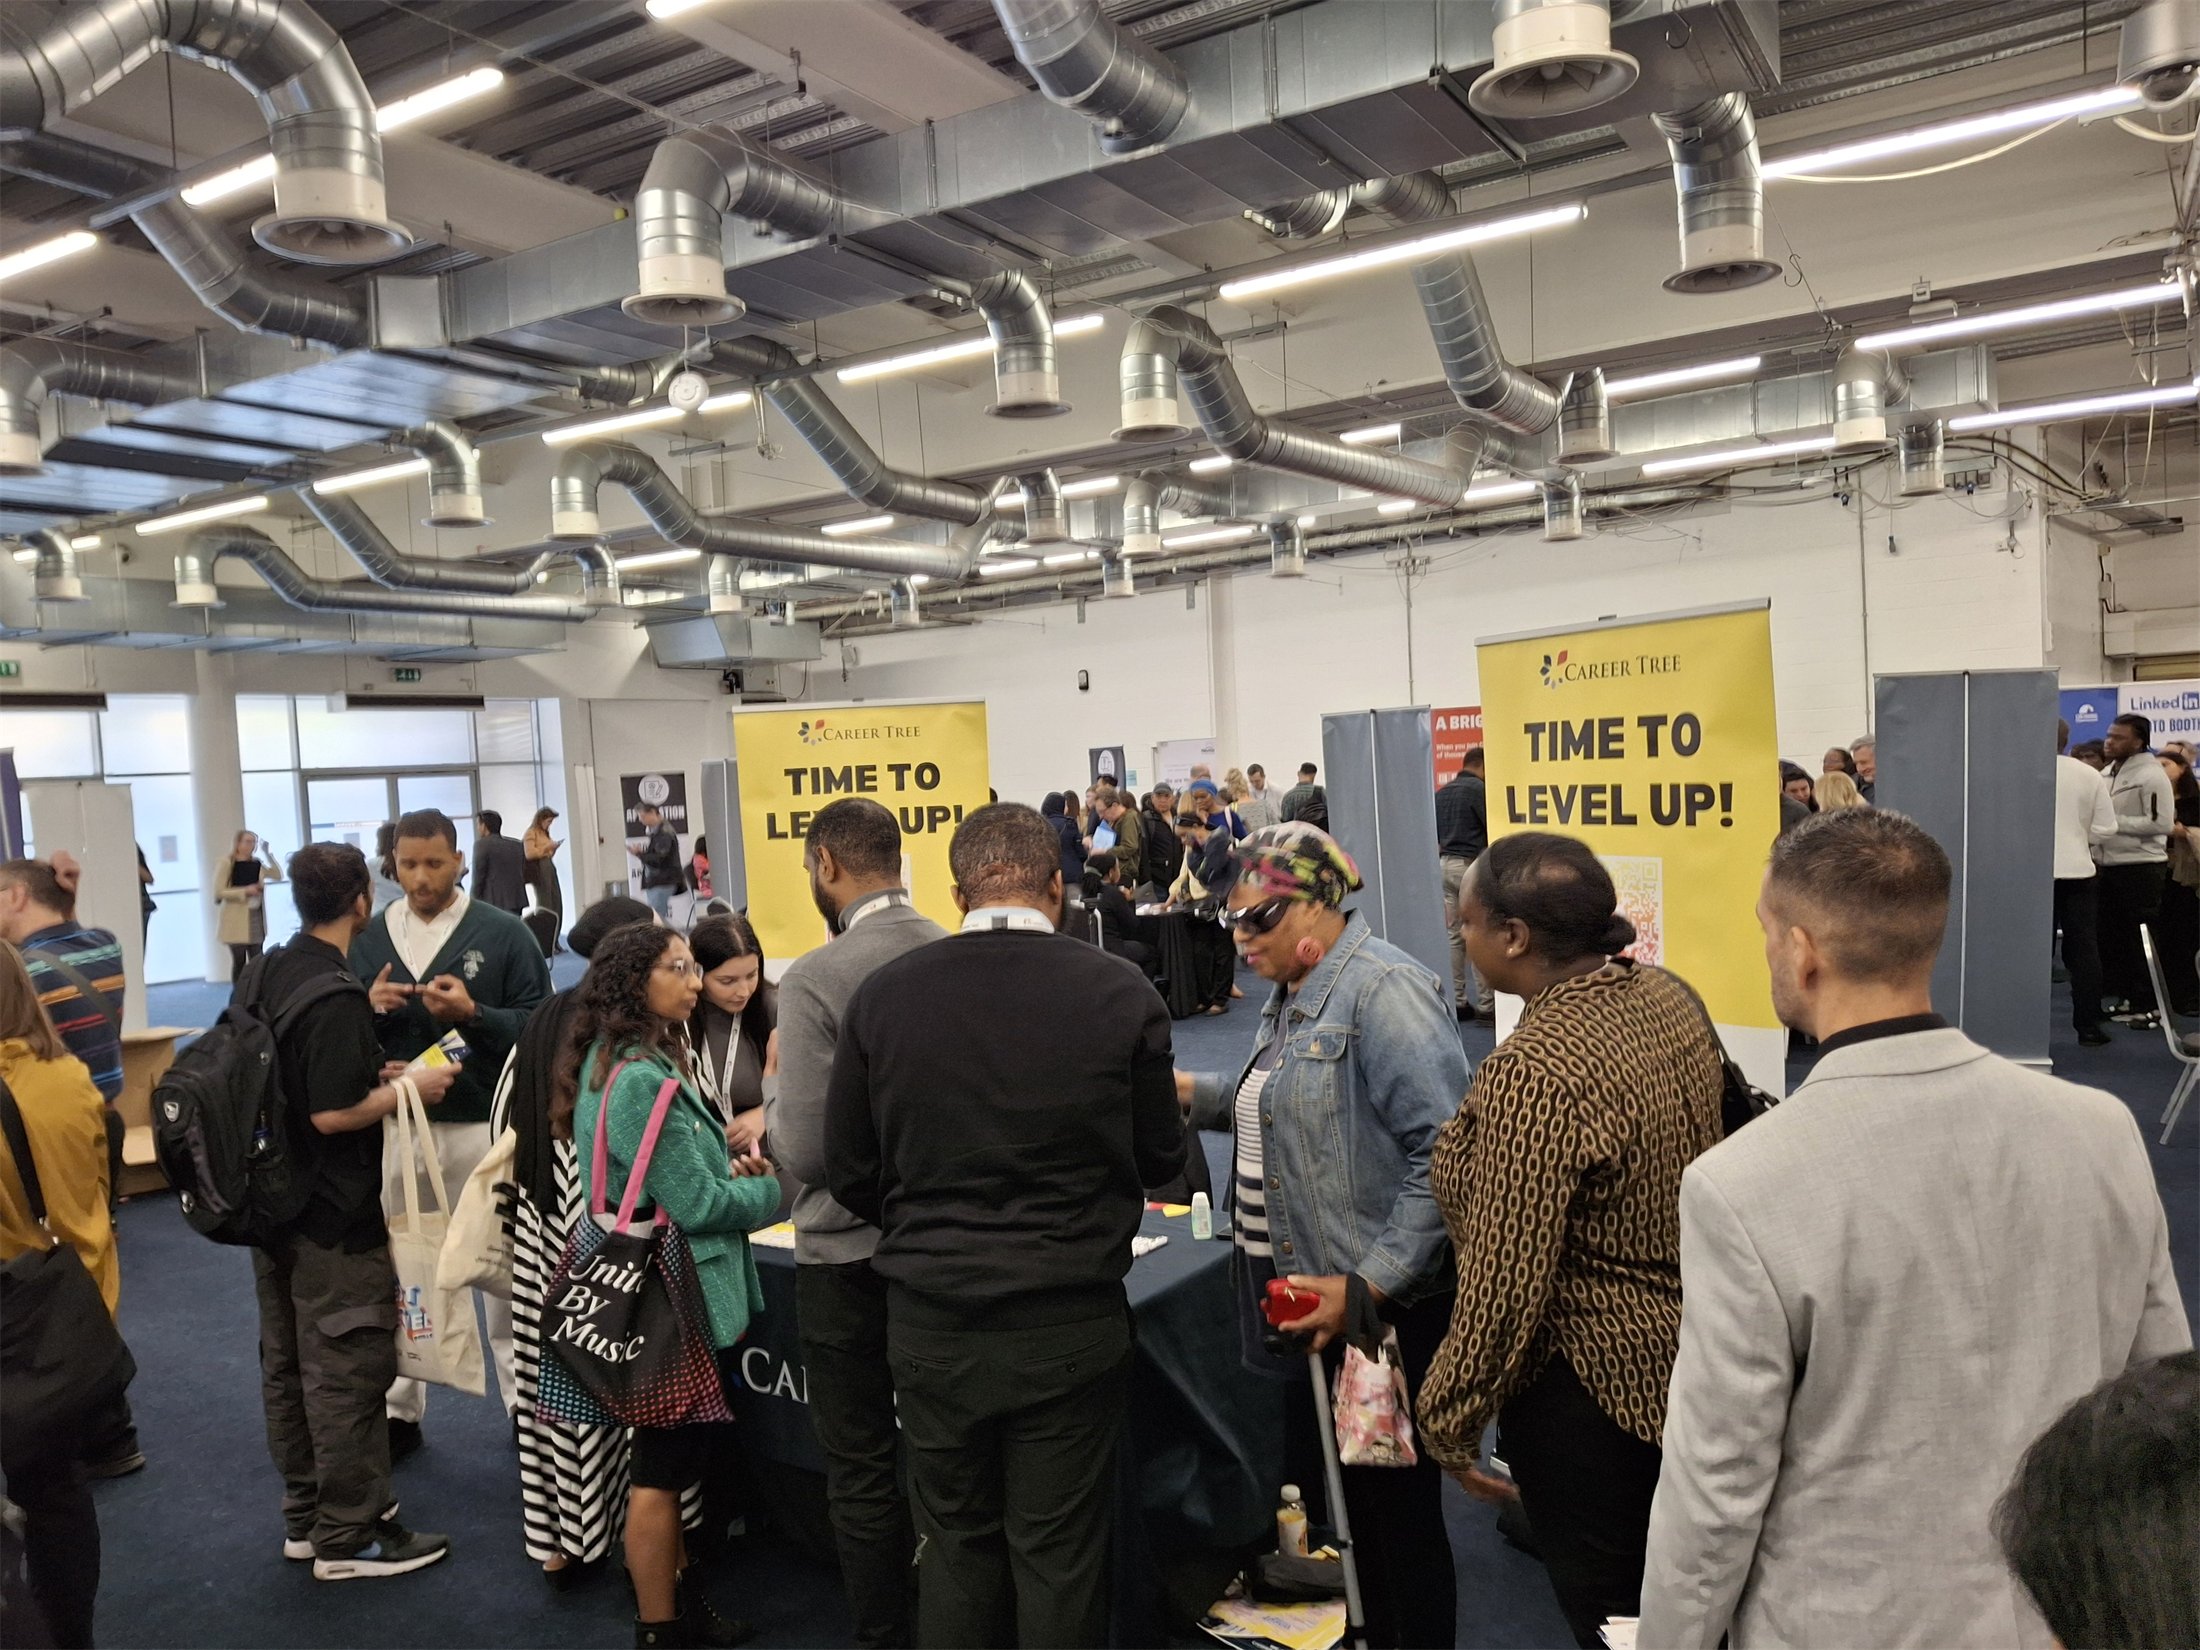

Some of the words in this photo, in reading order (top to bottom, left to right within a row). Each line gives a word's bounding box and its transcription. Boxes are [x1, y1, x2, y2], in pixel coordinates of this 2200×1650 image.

[1564, 660, 1632, 682] CAREER
[1636, 654, 1682, 676] TREE
[823, 727, 880, 742] CAREER
[884, 725, 921, 739] TREE
[1436, 715, 1448, 731] A
[1523, 716, 1625, 763] TIME
[1636, 711, 1702, 759] TO
[784, 764, 878, 796] TIME
[887, 761, 941, 792] TO
[1506, 783, 1638, 826] LEVEL
[1649, 781, 1734, 829] UP!
[554, 1284, 612, 1322] By
[548, 1315, 645, 1364] Music
